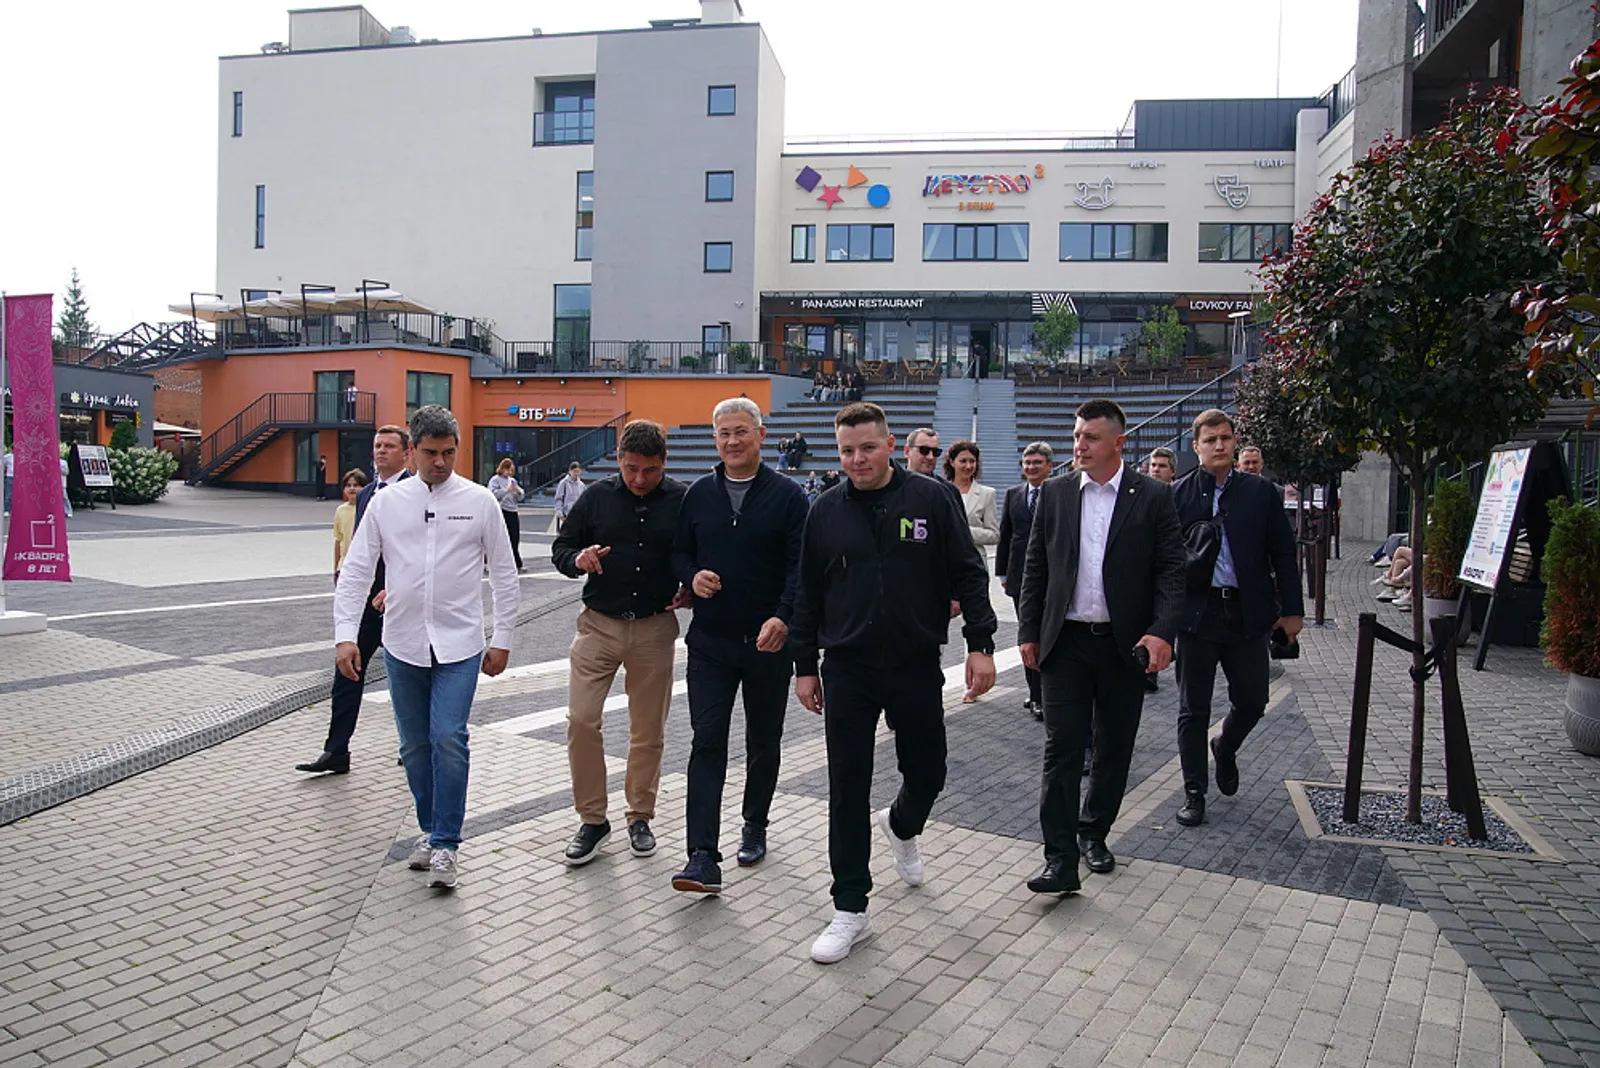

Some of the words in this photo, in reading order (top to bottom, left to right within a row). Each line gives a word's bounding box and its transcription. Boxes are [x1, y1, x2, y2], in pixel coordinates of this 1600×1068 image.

[1255, 158, 1286, 168] ТЕАТР
[802, 299, 856, 309] PAN-ASIAN
[858, 299, 925, 308] RESTAURANT
[1189, 300, 1234, 311] LOVKOV
[519, 408, 544, 421] ВТБ
[27, 564, 36, 573] 8
[38, 564, 57, 574] ЛЕТ
